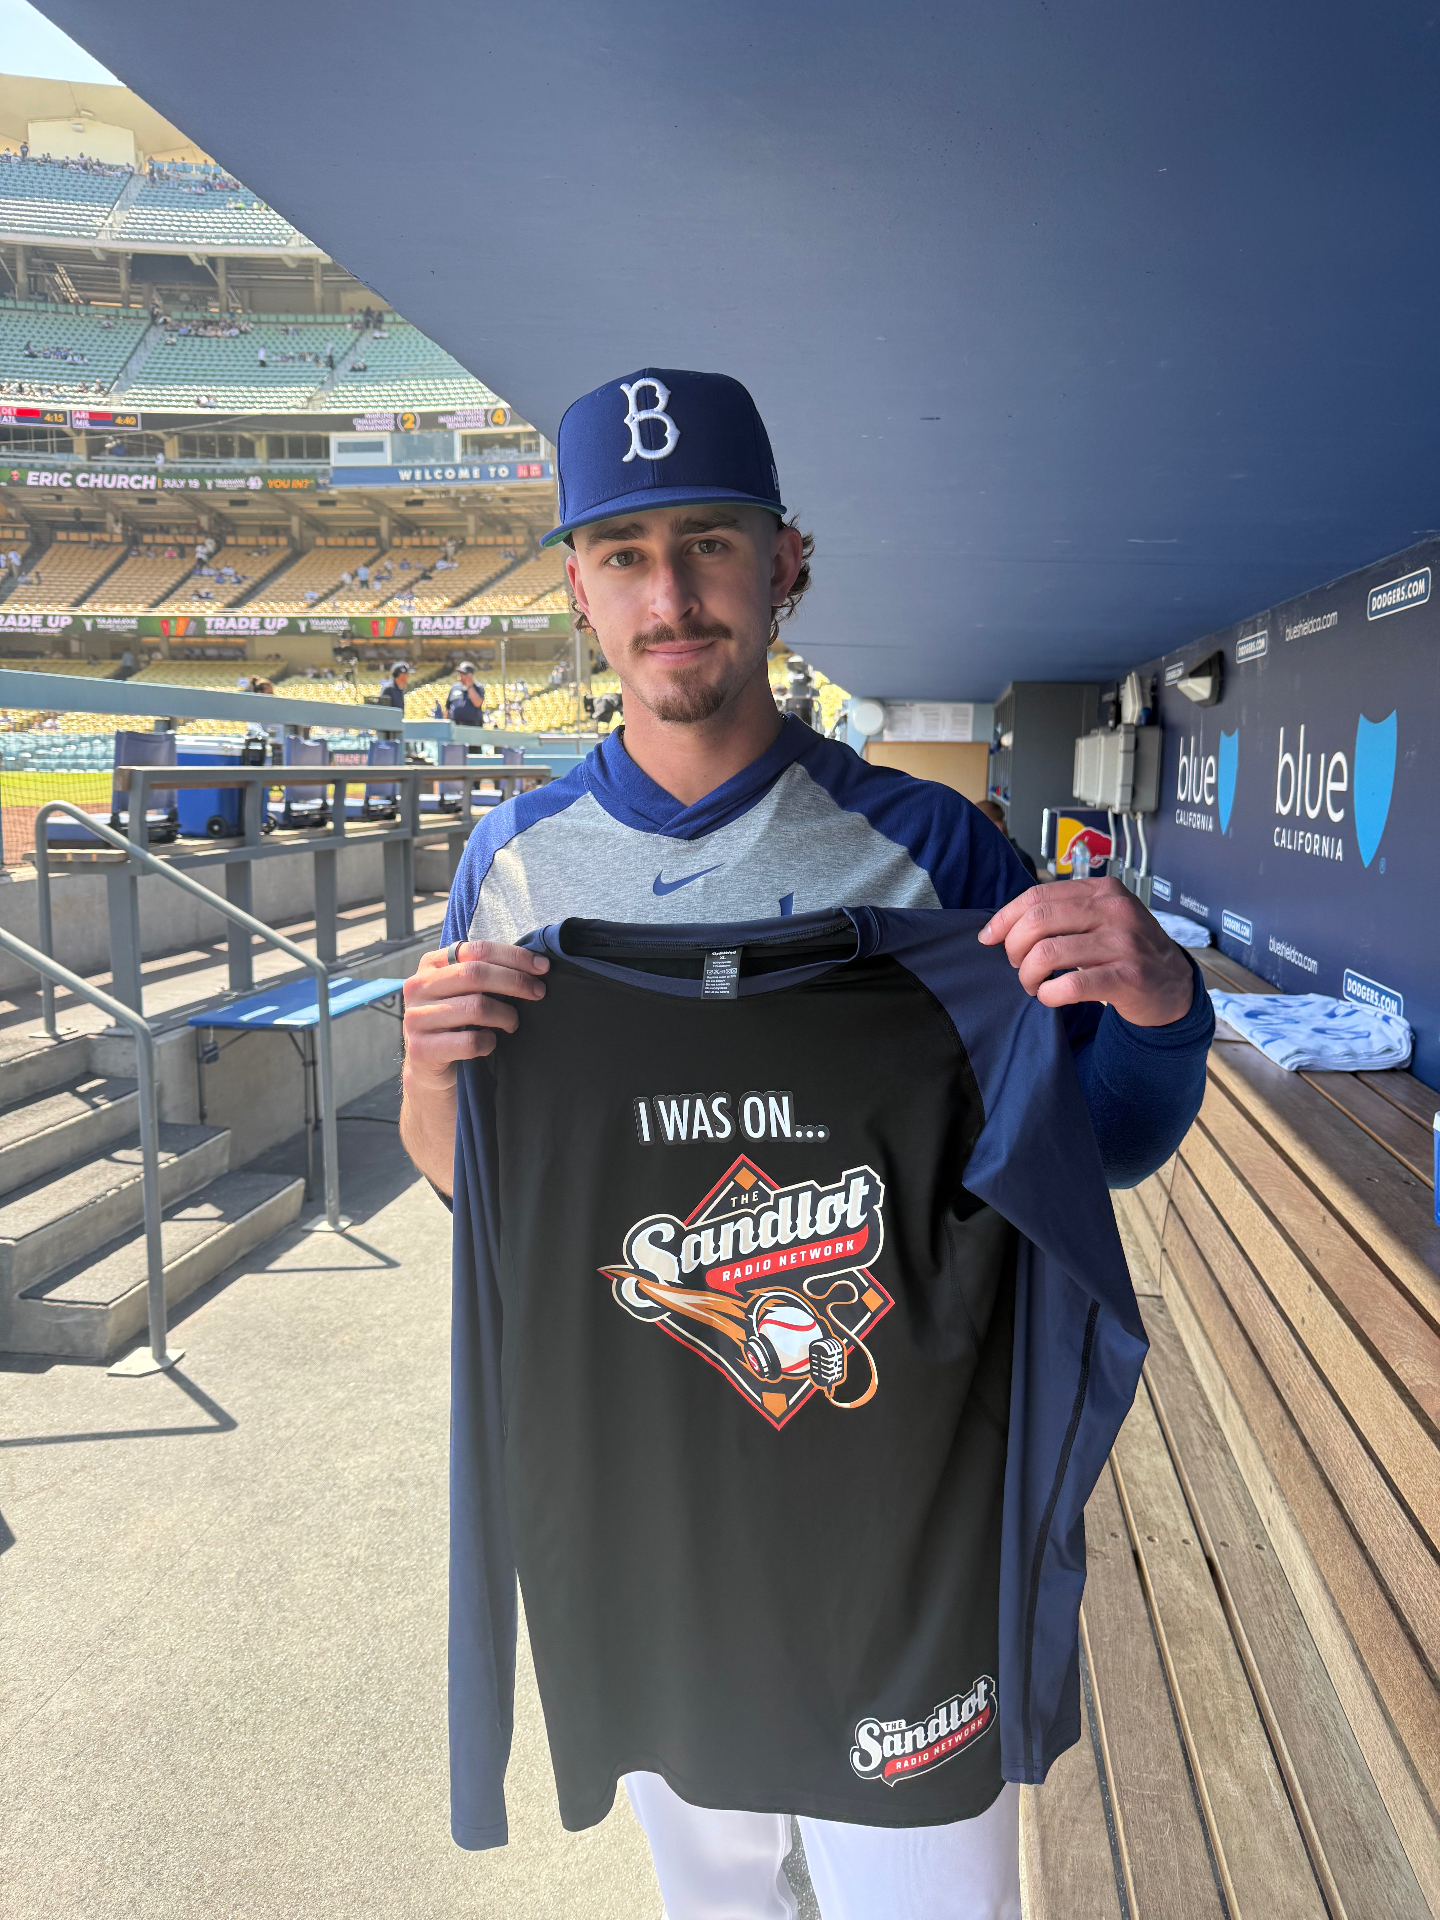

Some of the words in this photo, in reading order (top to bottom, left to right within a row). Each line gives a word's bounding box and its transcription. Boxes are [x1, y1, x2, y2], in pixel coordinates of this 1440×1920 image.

[1, 407, 17, 416] DET
[44, 413, 64, 423] 4:15
[115, 416, 136, 425] 4:40
[402, 413, 415, 429] 2
[492, 409, 505, 425] 4
[620, 377, 681, 462] B
[26, 471, 72, 487] ERIC
[75, 473, 156, 490] CHURCH
[163, 479, 186, 489] JULY
[267, 479, 290, 489] YOU
[399, 466, 481, 481] WELCOME
[488, 464, 509, 478] TO
[1371, 577, 1425, 612] DODGERS.COM
[47, 615, 73, 629] UP
[204, 616, 262, 630] TRADE
[263, 616, 289, 631] UP
[411, 615, 466, 630] TRADE
[468, 615, 492, 630] UP
[1285, 611, 1338, 642] blueshieldca.com
[1176, 735, 1216, 806] blue
[1276, 724, 1349, 823] blue
[1176, 808, 1214, 833] CALIFORNIA
[1274, 826, 1343, 862] CALIFORNIA
[1223, 915, 1250, 937] DODGERS.COM
[1268, 935, 1318, 975] blueshieldca.com
[1346, 977, 1398, 1016] DODGERS.COM
[638, 1100, 651, 1142] I
[657, 1096, 732, 1141] WAS
[743, 1096, 826, 1139] ON...
[730, 1190, 760, 1208] THE
[621, 1176, 870, 1308] Sandlot
[721, 1258, 772, 1283] RADIO
[778, 1238, 856, 1267] NETWORK
[852, 1680, 988, 1772] Sandlot
[885, 1721, 903, 1731] THE
[895, 1752, 929, 1770] RADIO
[933, 1717, 984, 1756] NETWORK
